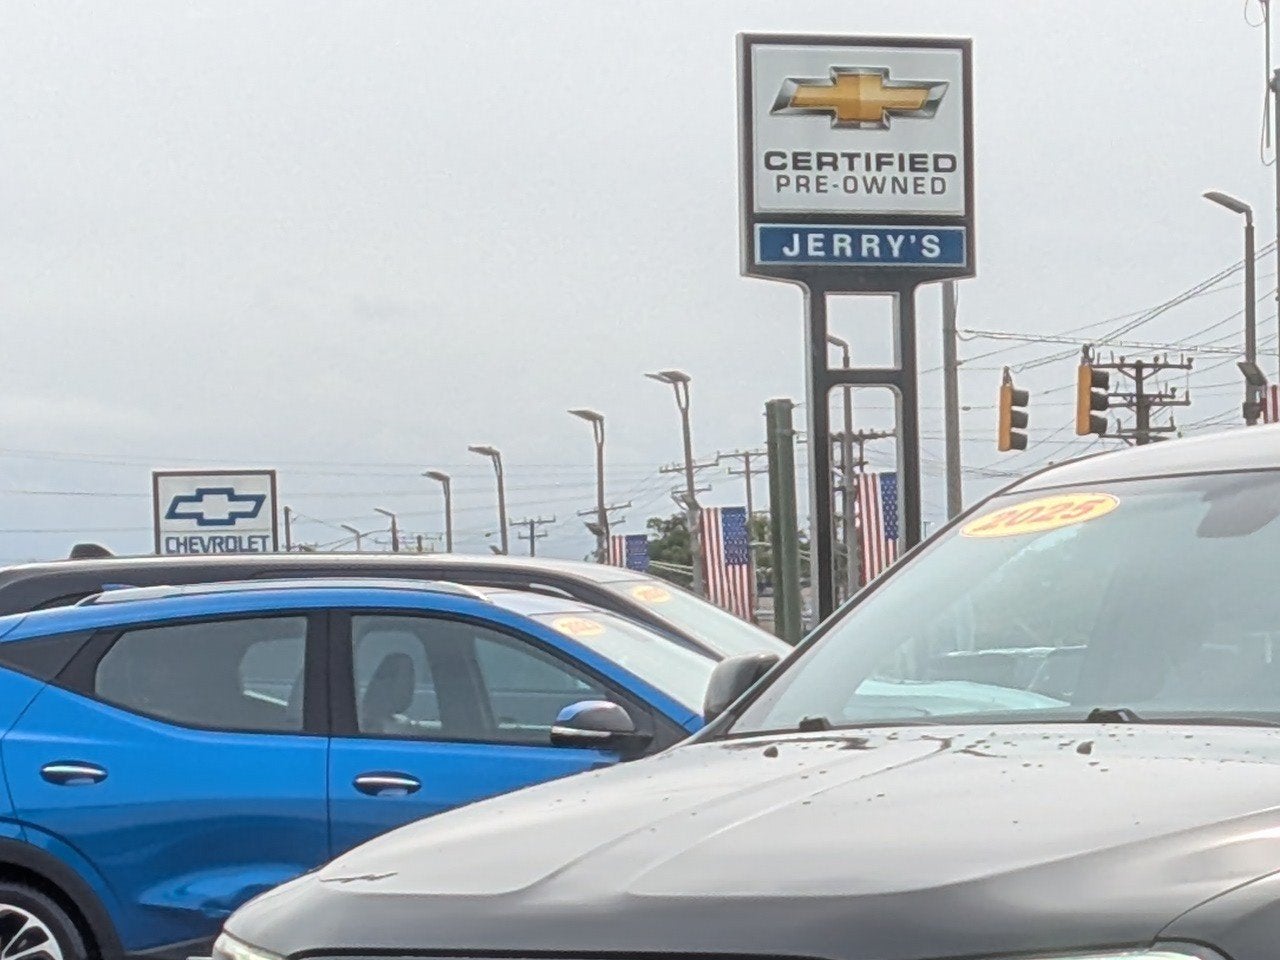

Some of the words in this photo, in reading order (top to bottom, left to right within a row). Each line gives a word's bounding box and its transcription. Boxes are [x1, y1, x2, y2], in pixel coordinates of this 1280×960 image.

[764, 151, 957, 173] CERTIFIED
[776, 175, 946, 195] PRE-OWNED
[782, 233, 941, 258] JERRY'S
[972, 499, 1106, 532] 2025
[165, 535, 269, 554] CHEVROLET
